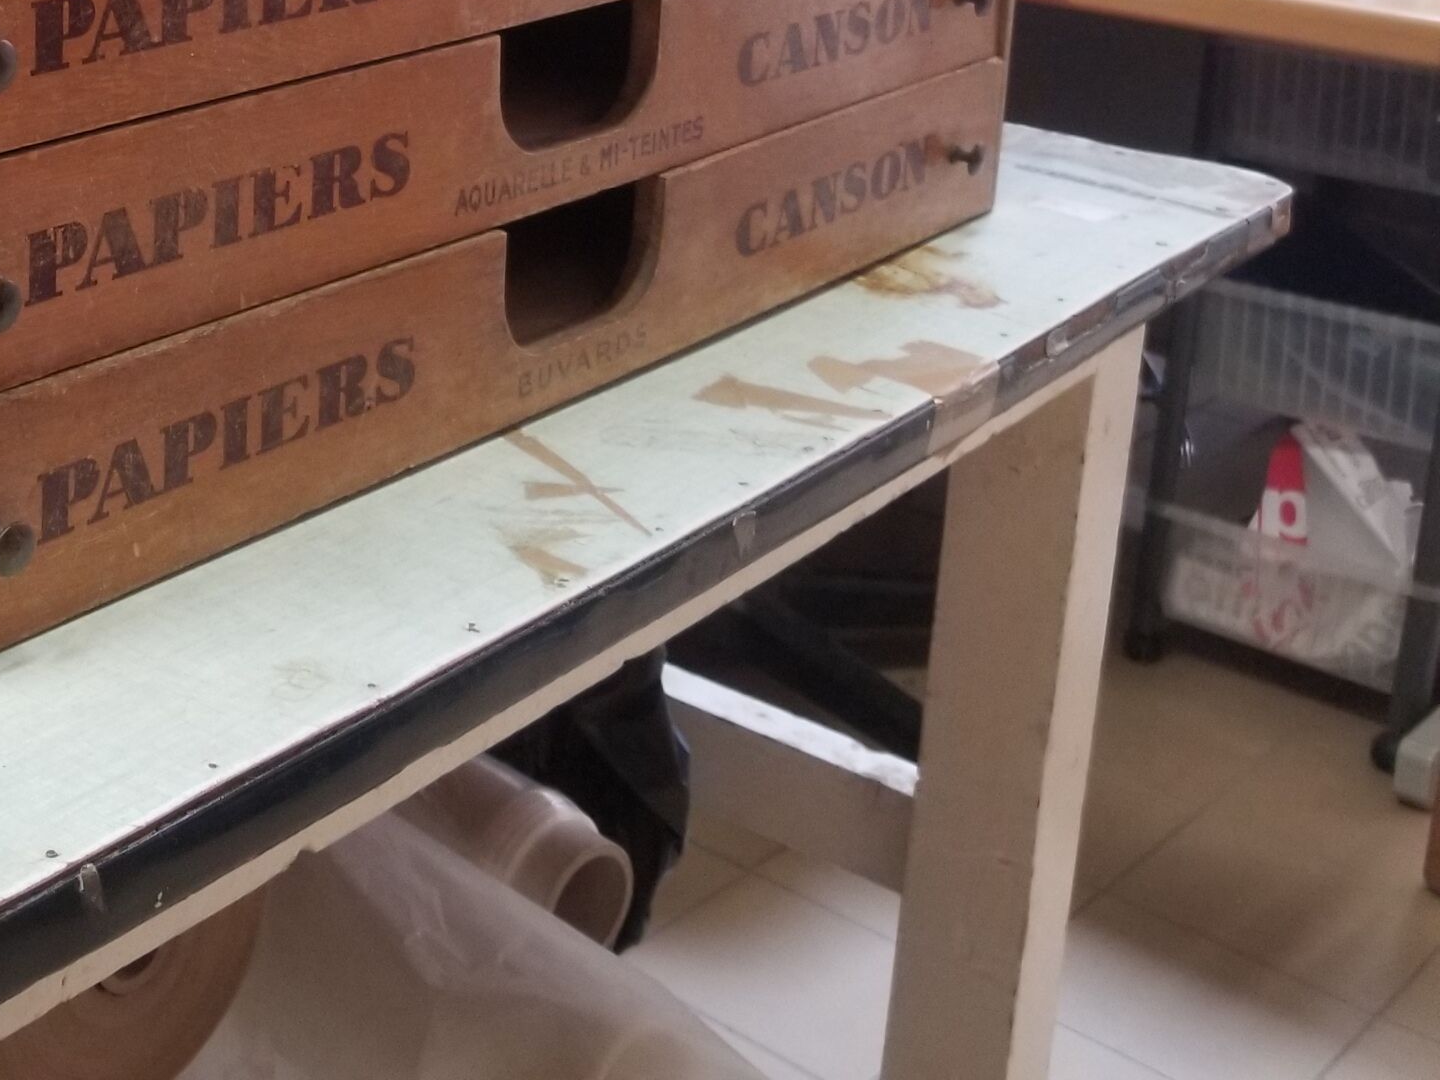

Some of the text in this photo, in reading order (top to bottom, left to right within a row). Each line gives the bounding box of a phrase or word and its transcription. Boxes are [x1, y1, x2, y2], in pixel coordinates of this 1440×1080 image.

[24, 130, 410, 308] PAPIERS
[454, 156, 574, 217] AQUARELLE
[599, 116, 705, 171] MI-TEINTES
[37, 138, 932, 545] PAPIERS CANSON
[518, 322, 647, 399] BUVARDS
